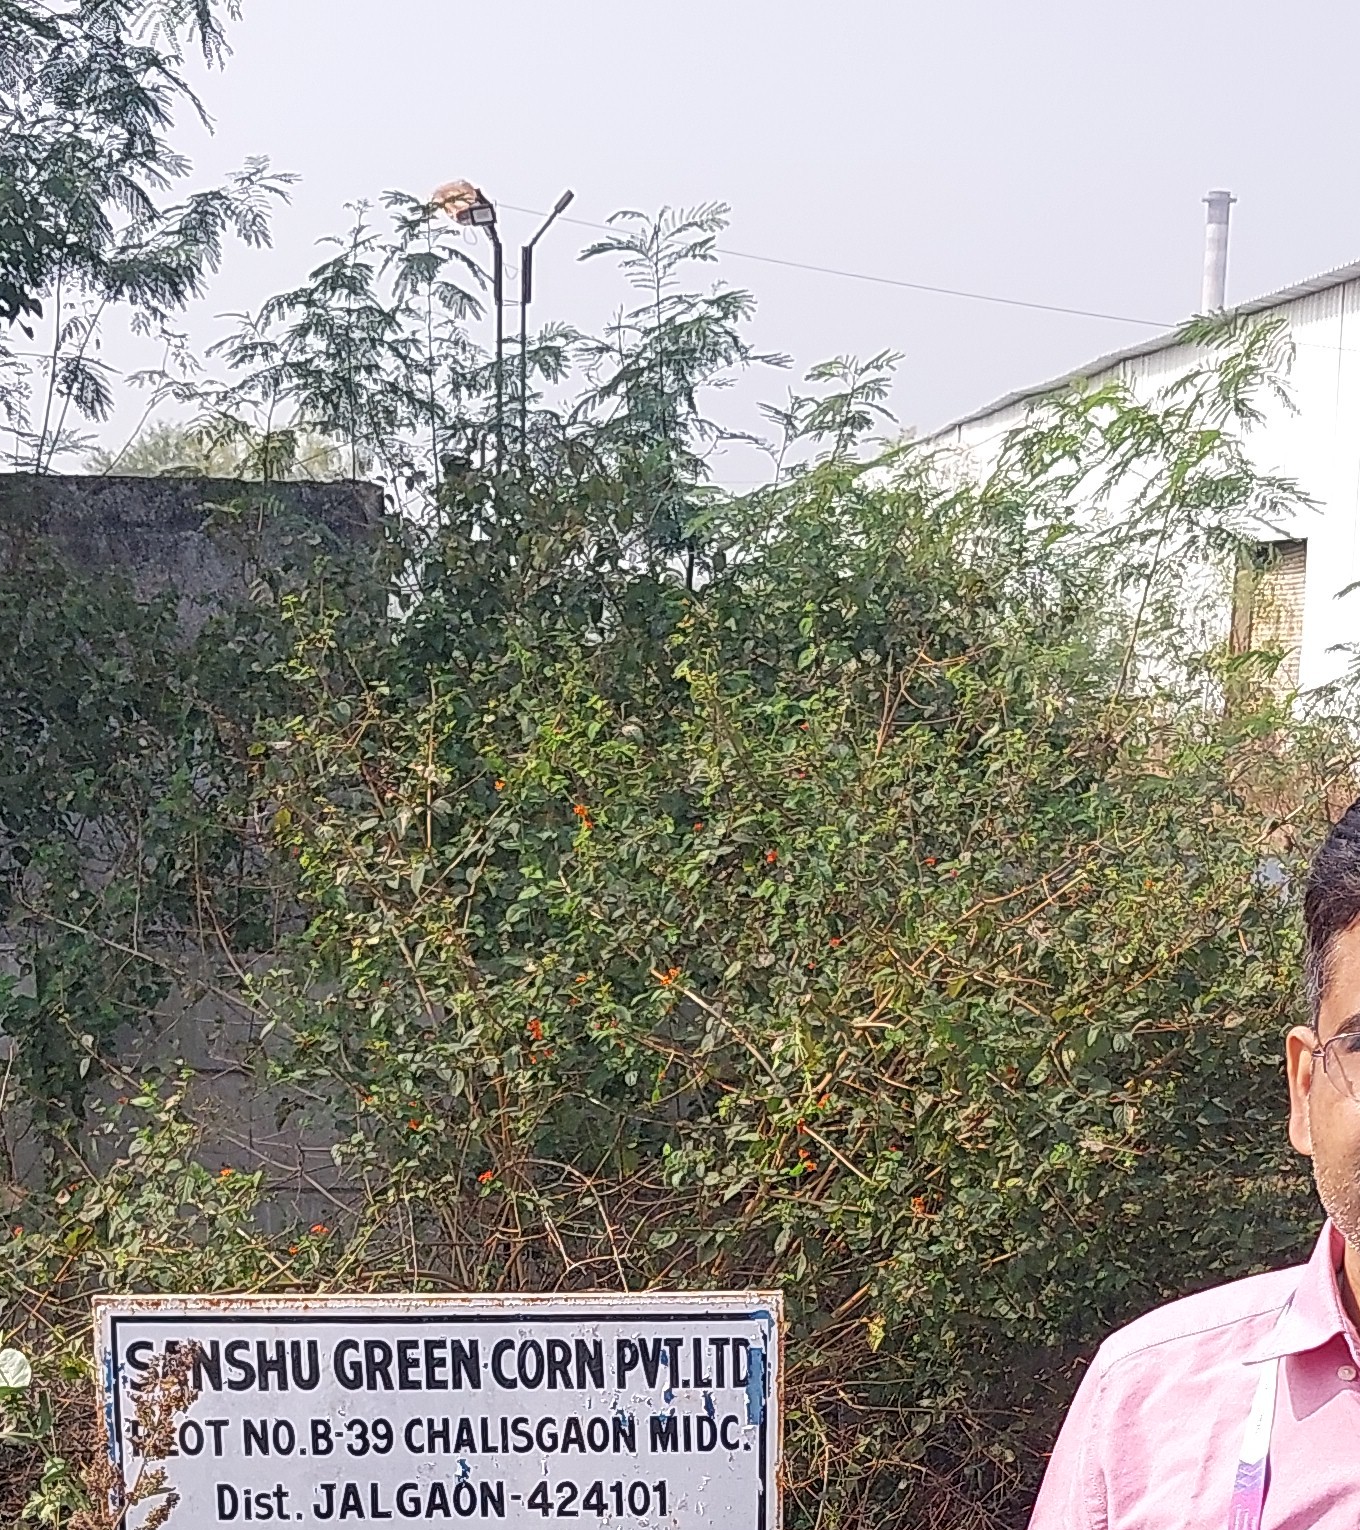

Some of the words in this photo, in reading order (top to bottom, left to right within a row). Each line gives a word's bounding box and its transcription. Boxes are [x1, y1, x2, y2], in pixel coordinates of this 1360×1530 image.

[333, 1338, 482, 1391] GREEN
[492, 1337, 605, 1389] CORN
[130, 1417, 230, 1457] OT
[404, 1415, 637, 1455] CHALISGAON
[216, 1482, 304, 1521] Dist.
